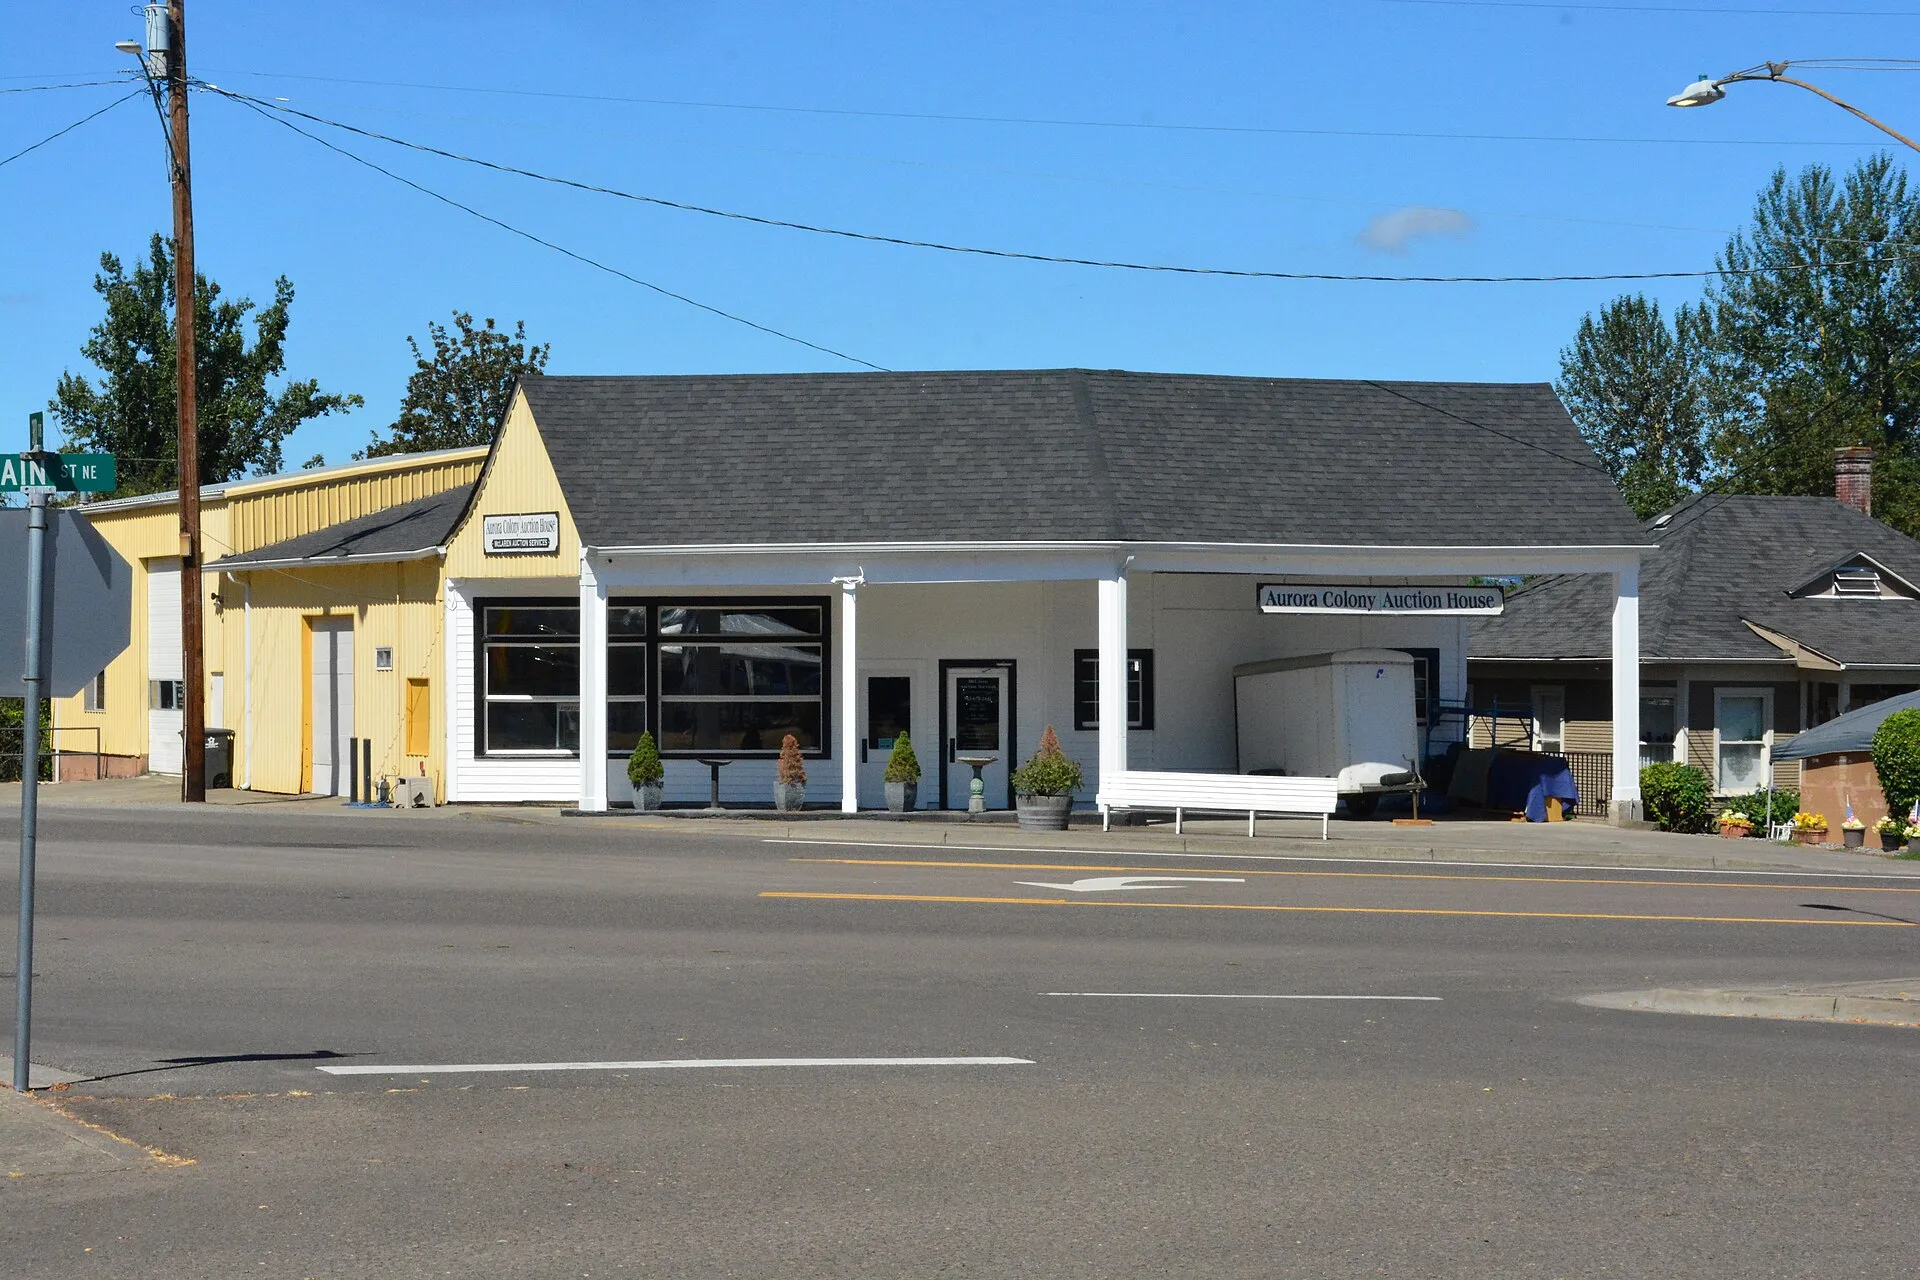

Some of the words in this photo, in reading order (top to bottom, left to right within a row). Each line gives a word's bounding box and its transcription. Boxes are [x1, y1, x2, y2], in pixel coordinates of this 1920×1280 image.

[60, 464, 77, 478] ST
[82, 465, 97, 479] NE
[1265, 590, 1317, 608] Aurora
[1322, 591, 1376, 611] Colony
[1382, 591, 1443, 609] Auction
[1446, 592, 1495, 609] House
